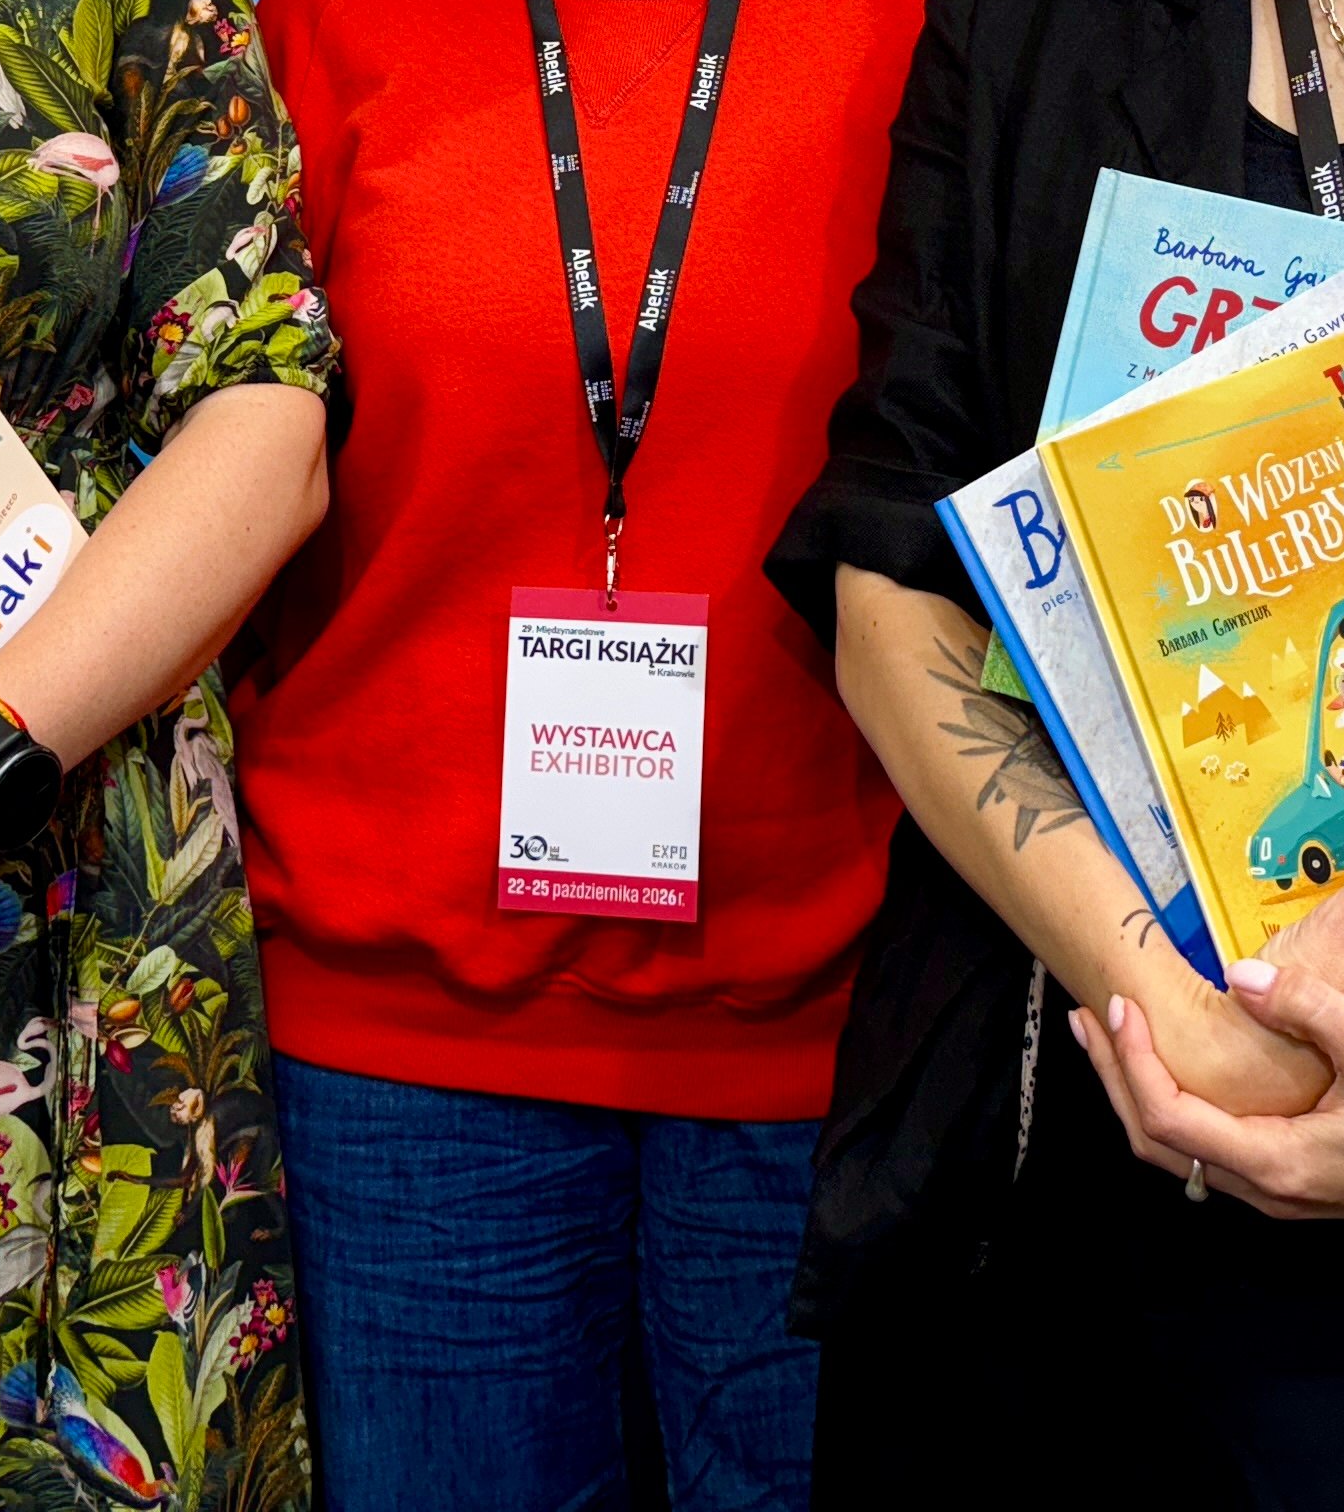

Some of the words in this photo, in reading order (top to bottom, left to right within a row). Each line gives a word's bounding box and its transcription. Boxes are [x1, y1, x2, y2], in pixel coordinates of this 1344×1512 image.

[542, 40, 567, 96] Abedik
[689, 53, 719, 112] Abedik
[1310, 161, 1342, 221] bedik
[1153, 227, 1265, 277] Barbara
[571, 248, 598, 312] Abedik
[638, 268, 670, 332] Abedik
[1040, 589, 1079, 616] pies,
[536, 625, 605, 638] Międzynarodowe
[1157, 627, 1209, 658] BARBARA
[1212, 603, 1273, 636] GAWRYLUK
[518, 636, 591, 660] TARGI
[597, 637, 696, 669] KSIĄŻKI
[657, 668, 696, 679] Krakowie
[531, 723, 677, 753] WYSTAWCA
[530, 750, 676, 781] EXHIBITOR
[509, 834, 548, 861] 30
[651, 844, 688, 860] EXPO
[507, 876, 550, 897] 22-25
[552, 880, 640, 904] października
